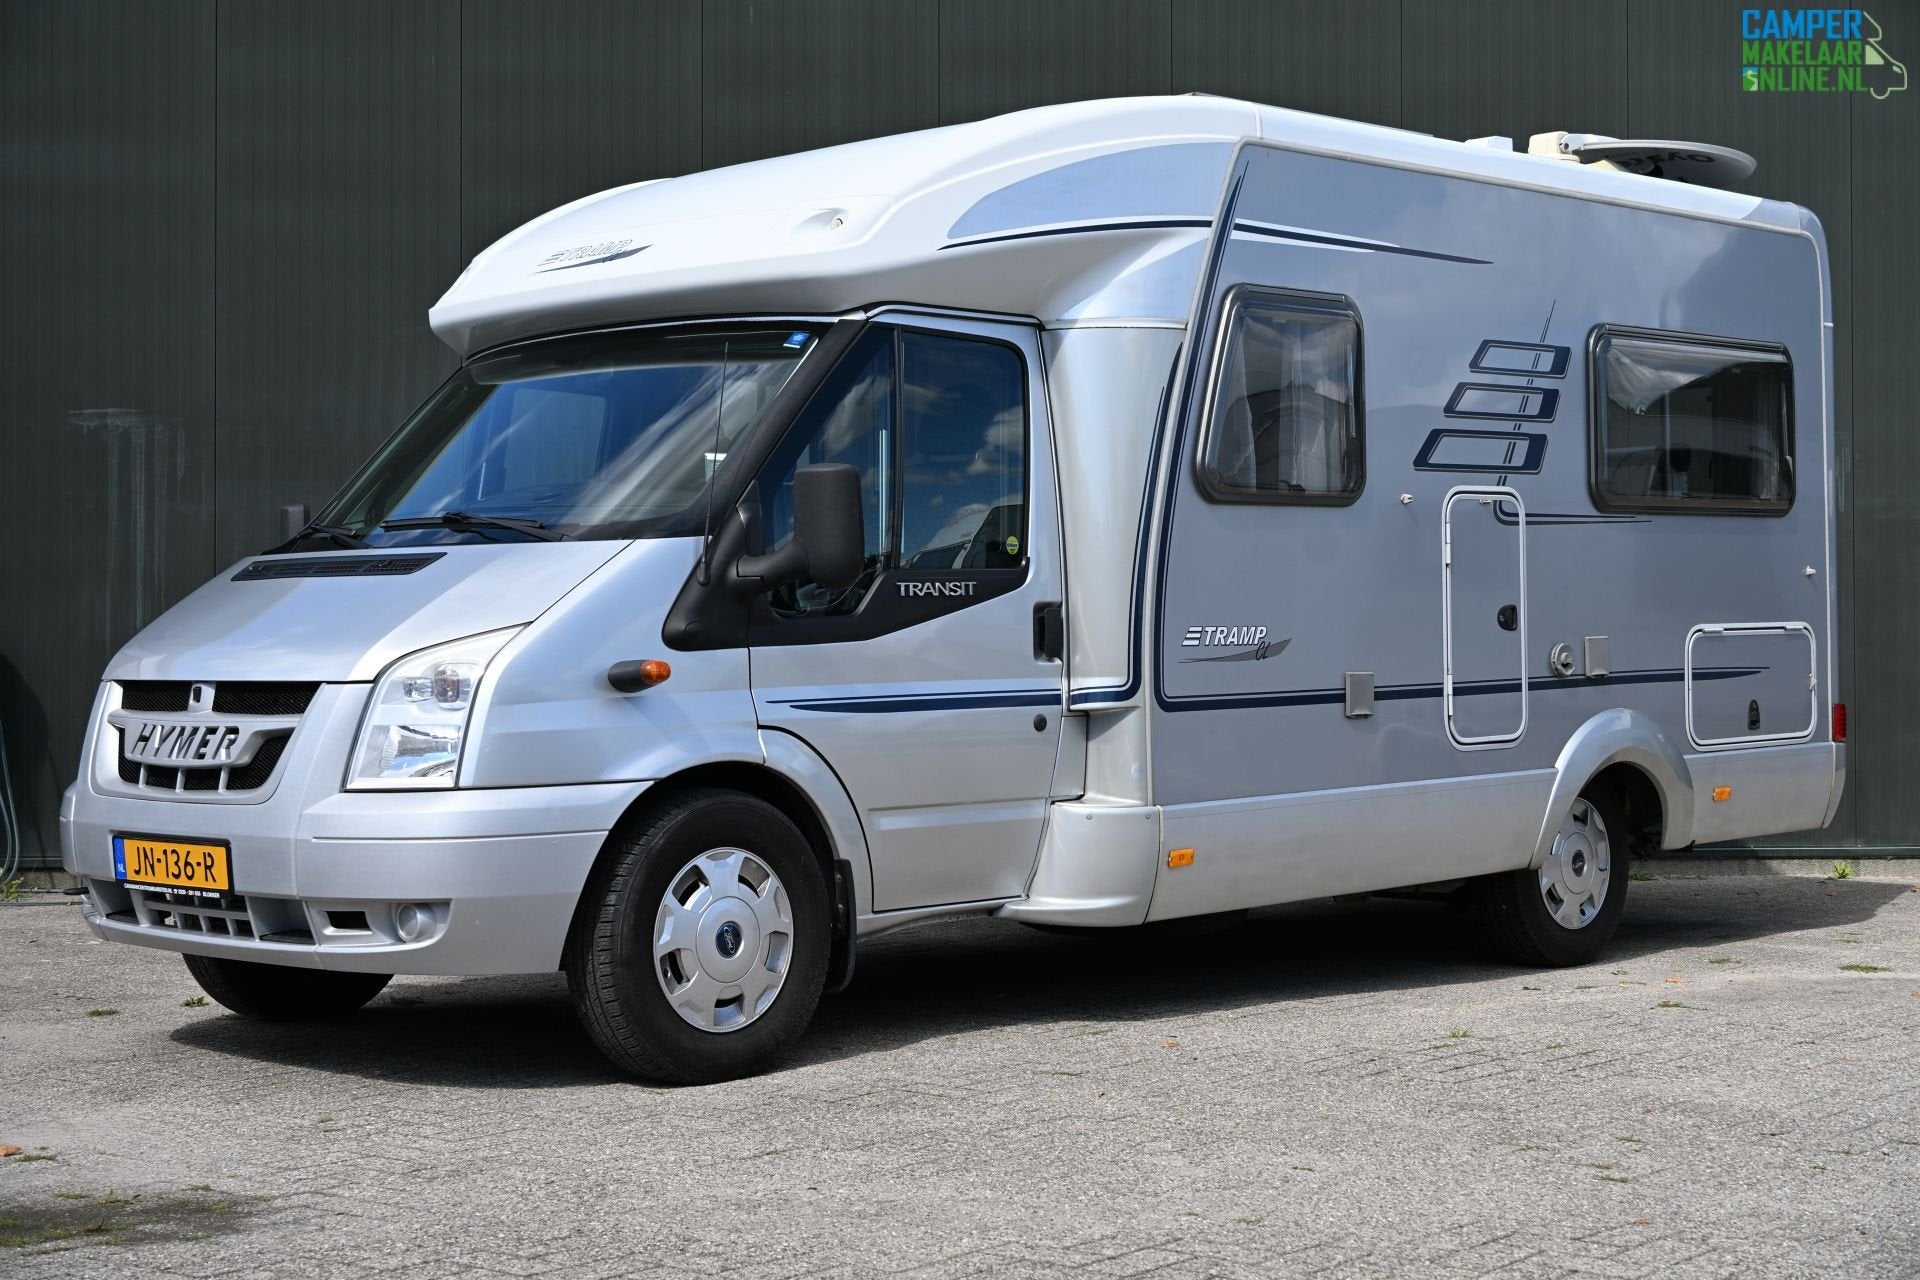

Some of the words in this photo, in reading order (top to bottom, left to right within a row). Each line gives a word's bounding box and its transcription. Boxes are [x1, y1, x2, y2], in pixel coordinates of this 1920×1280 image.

[896, 581, 977, 597] TRANSIT
[1204, 625, 1268, 647] TRAMP
[131, 723, 240, 760] HYMER
[117, 862, 126, 873] NL
[133, 845, 217, 883] JN-136-R
